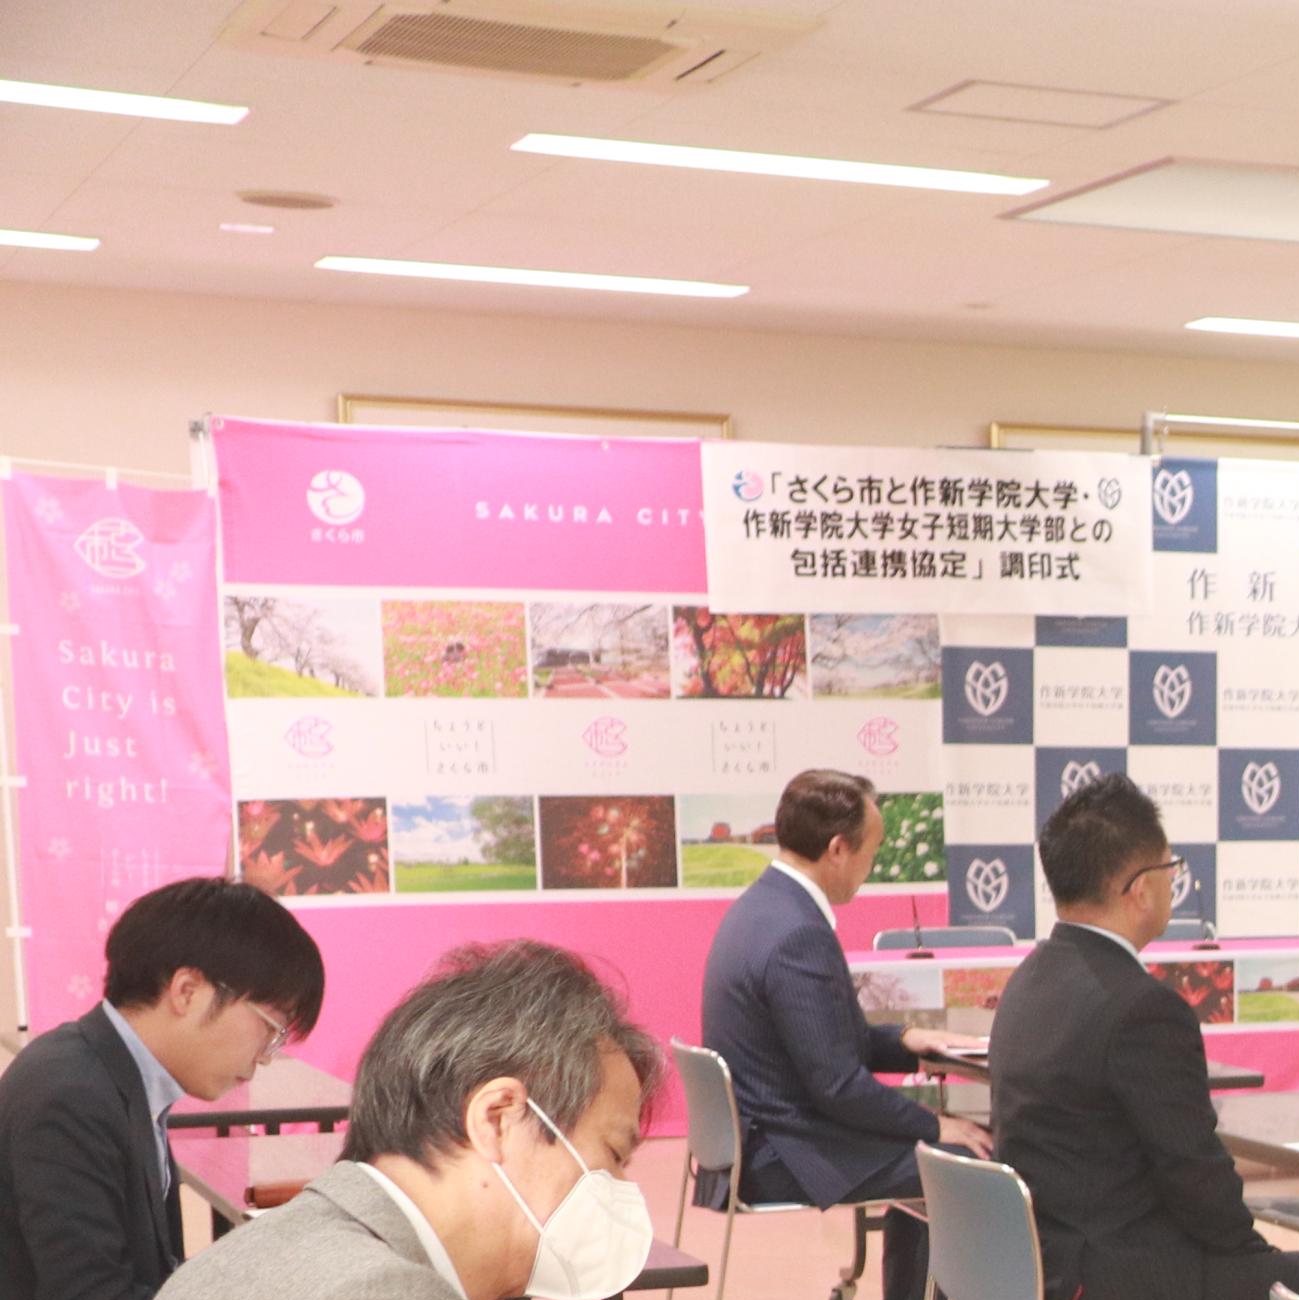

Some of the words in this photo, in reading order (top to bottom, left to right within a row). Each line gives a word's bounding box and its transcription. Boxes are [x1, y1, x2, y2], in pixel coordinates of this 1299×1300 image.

[475, 500, 613, 525] SAKURA
[743, 510, 1113, 543] 作新学院大学女子短期大学部との
[311, 528, 365, 544] さくら市
[58, 639, 177, 673] Sakura
[61, 685, 134, 719] City
[150, 689, 177, 716] is
[64, 731, 138, 760] Just
[66, 778, 170, 808] right!
